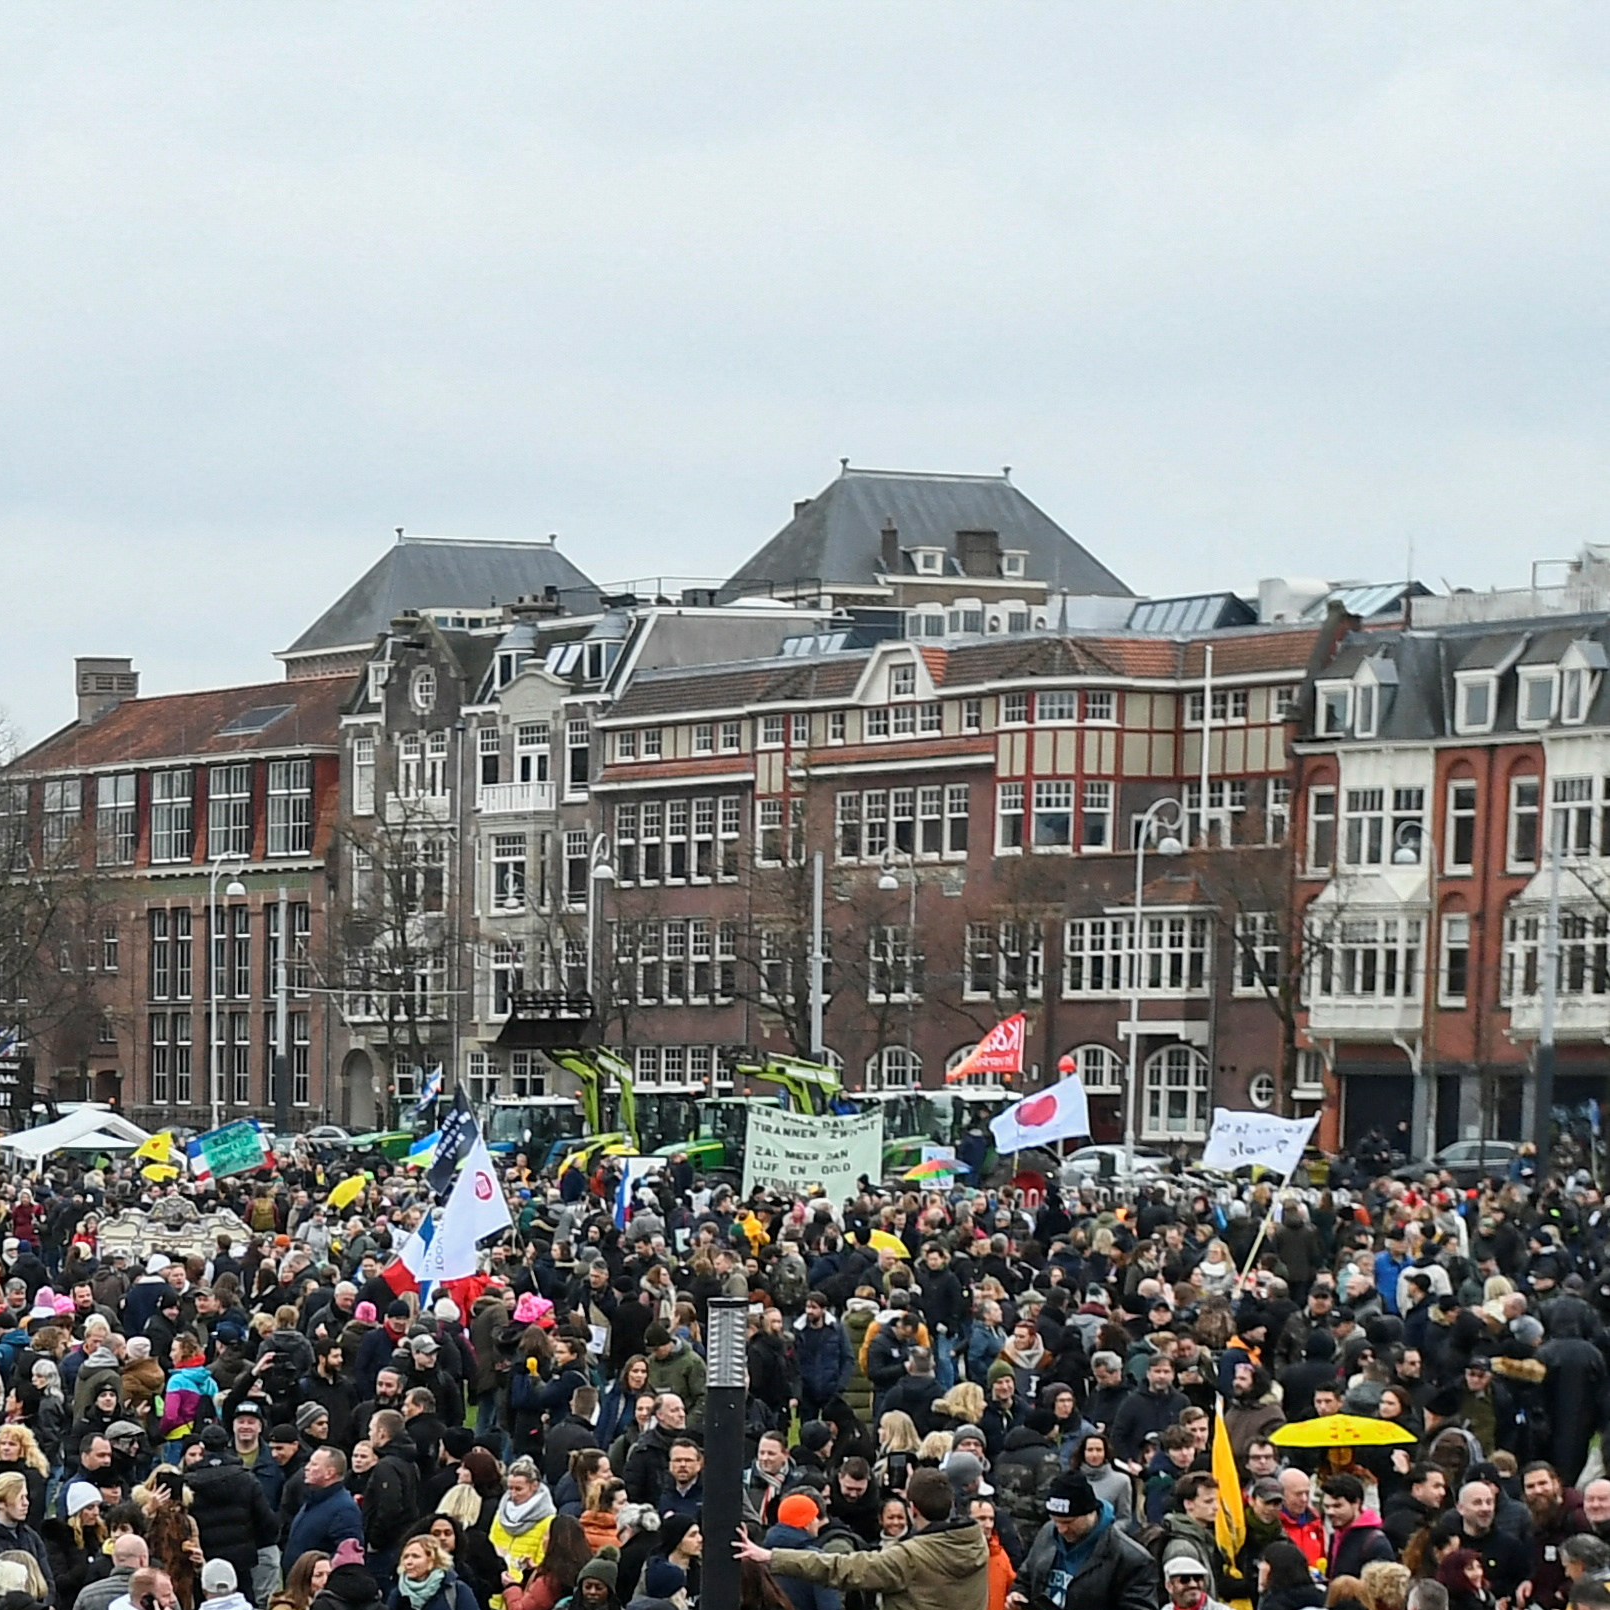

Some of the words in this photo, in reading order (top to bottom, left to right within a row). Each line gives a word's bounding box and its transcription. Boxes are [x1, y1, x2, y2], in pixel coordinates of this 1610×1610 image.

[753, 1121, 818, 1138] TIRANNEN
[754, 1145, 779, 1158] ZAL
[784, 1150, 820, 1161] MEER
[752, 1160, 780, 1173] LIJF
[790, 1165, 807, 1175] EN
